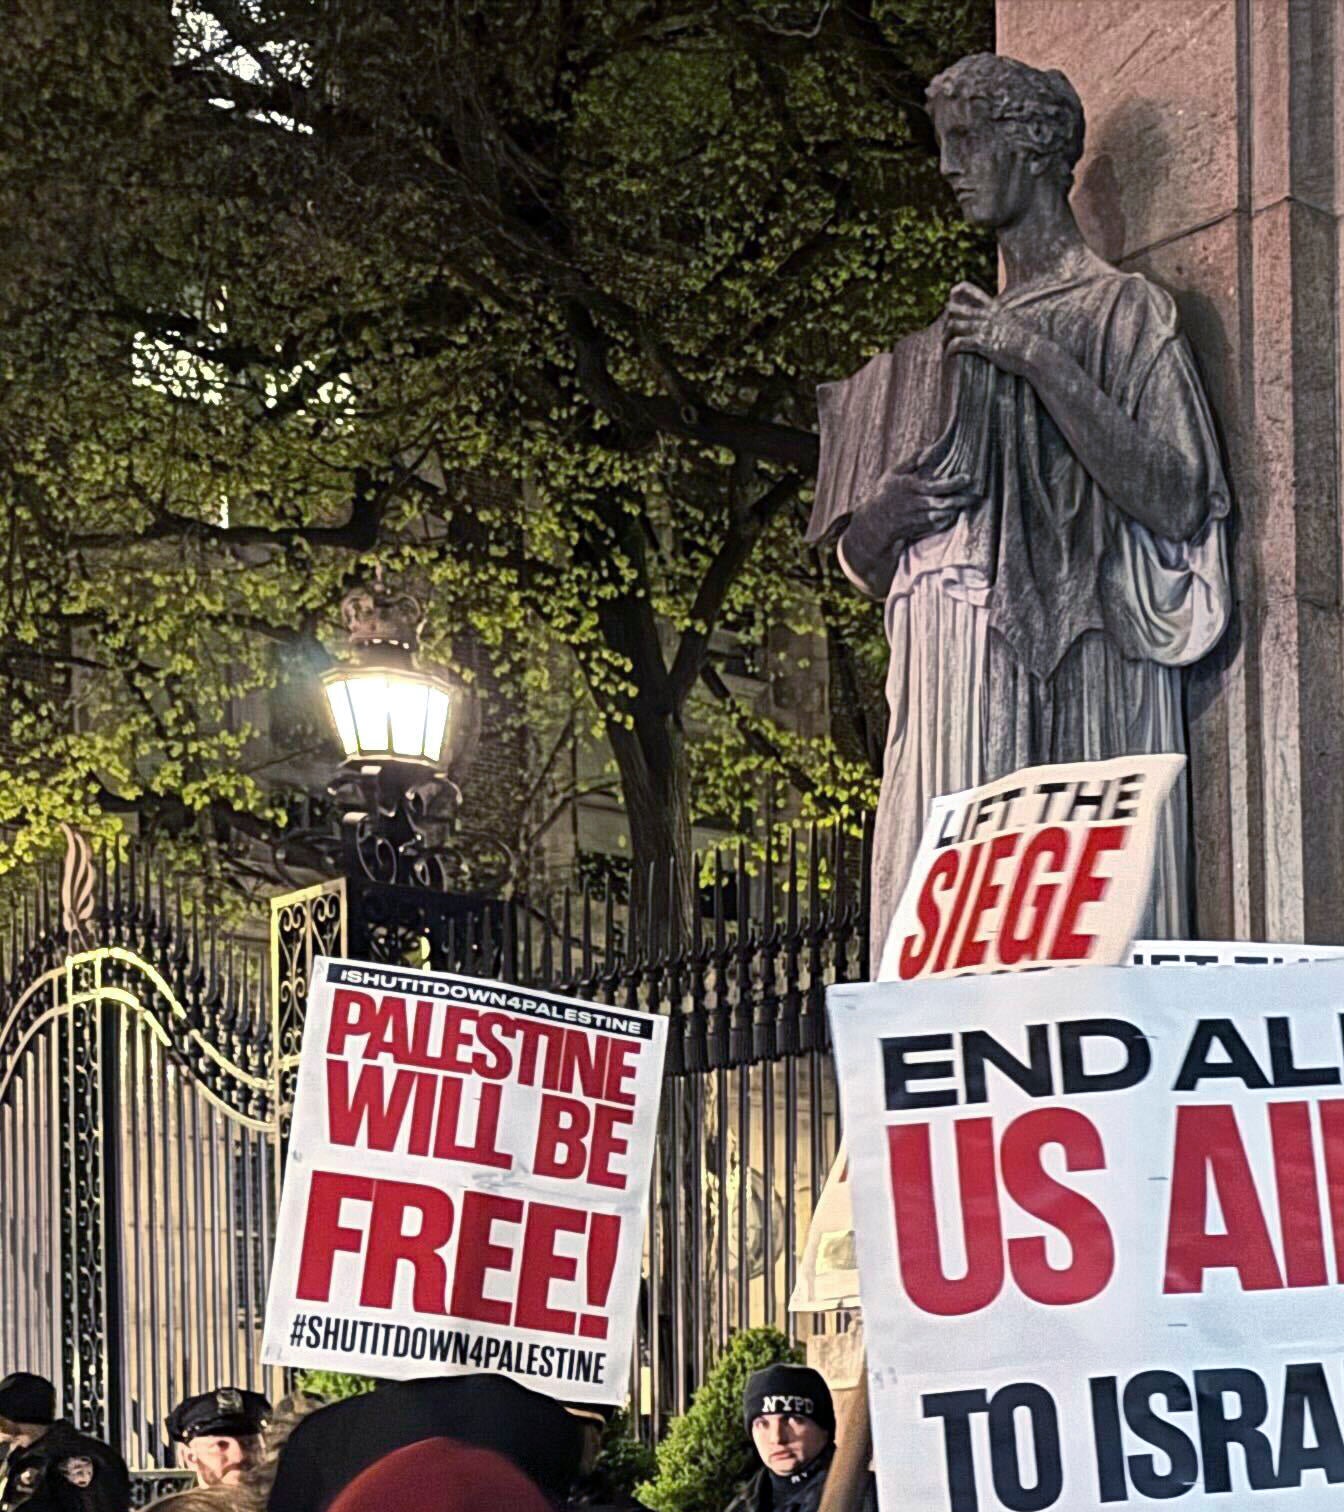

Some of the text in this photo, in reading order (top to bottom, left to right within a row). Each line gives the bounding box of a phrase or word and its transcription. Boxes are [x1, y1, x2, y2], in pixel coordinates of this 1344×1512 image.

[936, 773, 1145, 849] LIFT THE
[897, 824, 1132, 981] SIEGE
[326, 989, 642, 1106] PALESTINE
[879, 1018, 1153, 1110] END
[325, 1058, 634, 1190] WILL BE
[296, 1170, 622, 1340] FREE!
[886, 1106, 1115, 1316] US
[290, 1314, 607, 1385] #SHUTITDOWN4PALESTINE
[762, 1395, 814, 1414] NYPD
